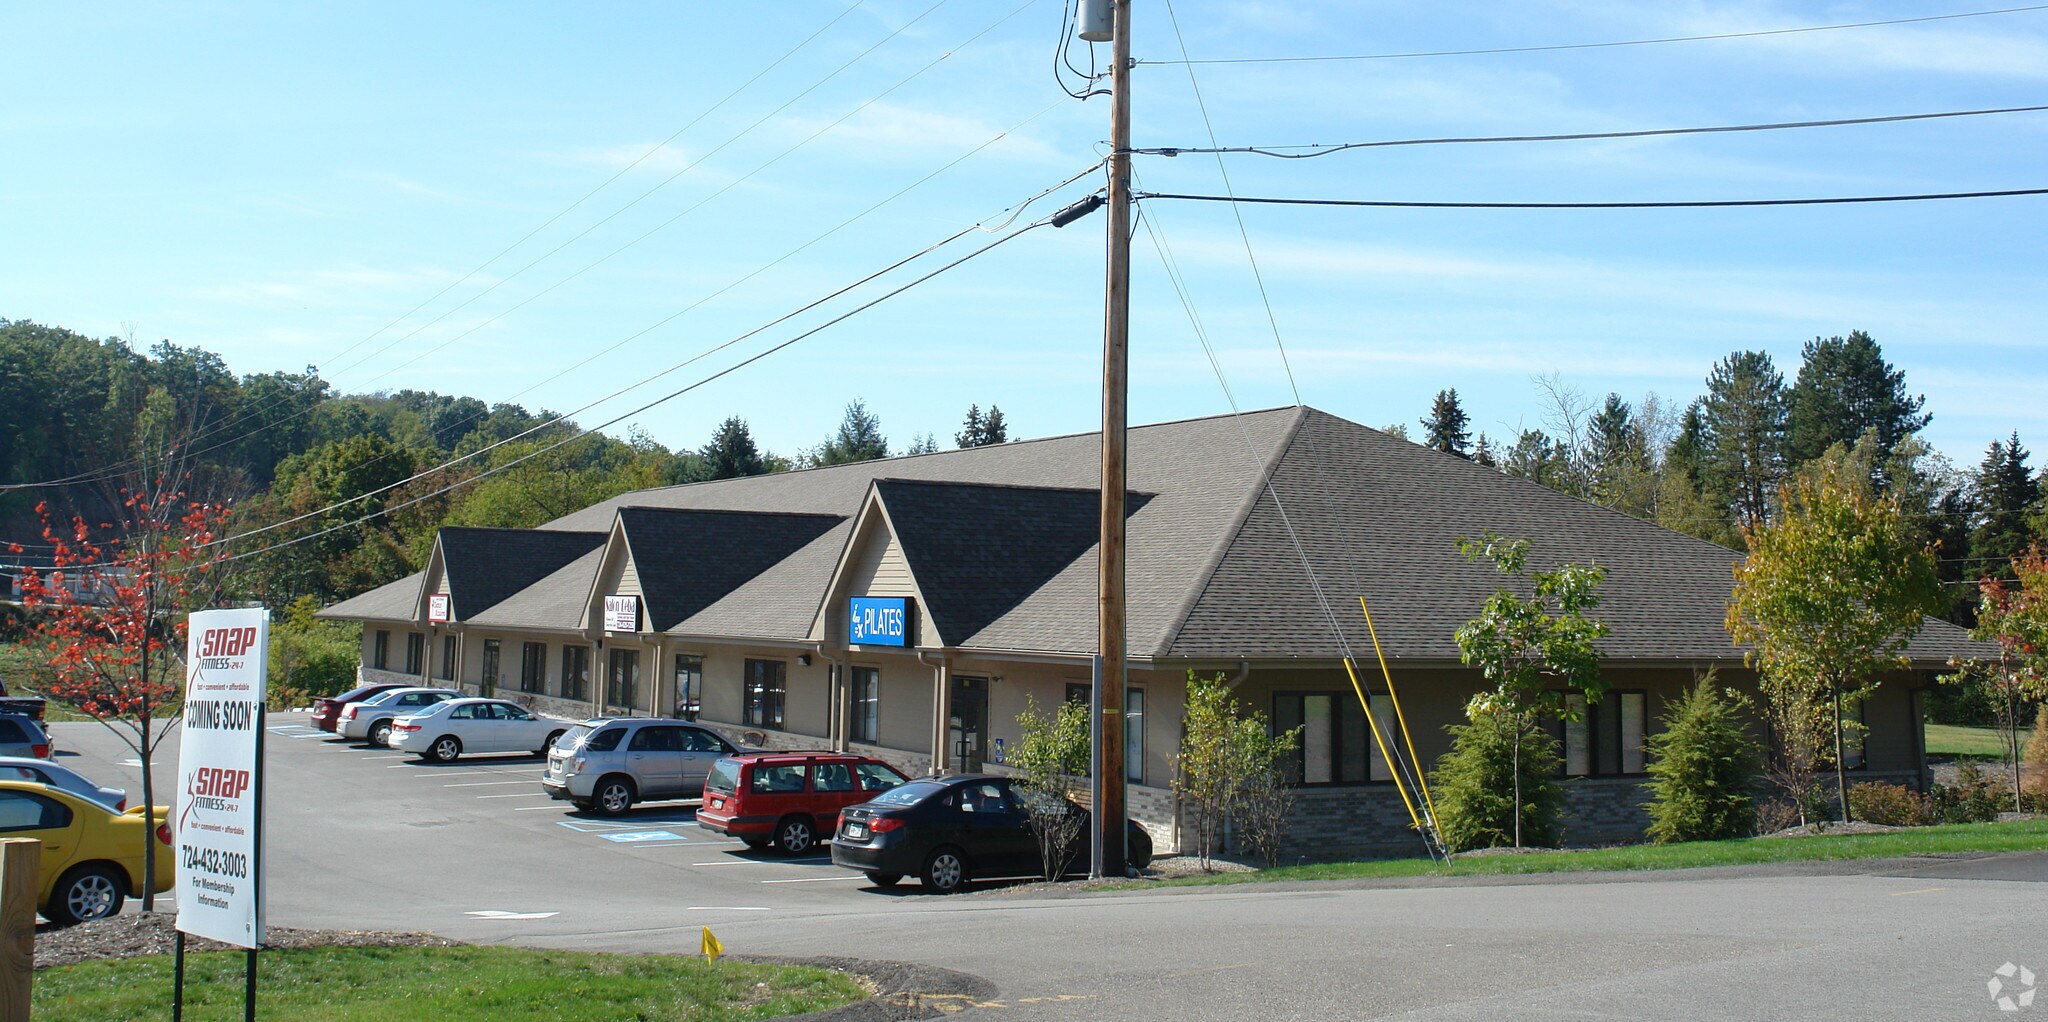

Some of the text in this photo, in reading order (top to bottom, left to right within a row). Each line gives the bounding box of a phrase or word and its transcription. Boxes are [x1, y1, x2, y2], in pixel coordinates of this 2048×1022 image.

[864, 608, 902, 636] PILATES
[188, 700, 252, 731] COMING SOON
[182, 844, 247, 880] 724-432-3003
[192, 876, 235, 897] For Membership
[197, 893, 229, 910] Information
